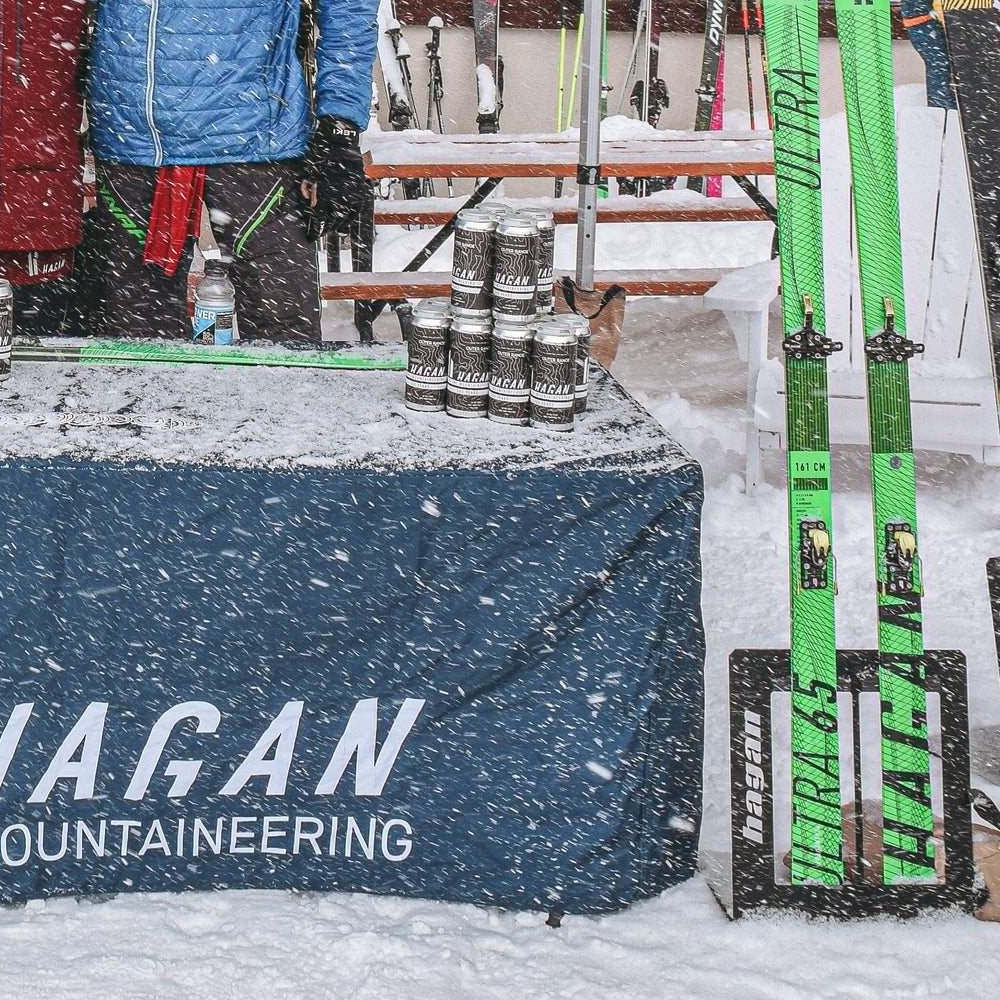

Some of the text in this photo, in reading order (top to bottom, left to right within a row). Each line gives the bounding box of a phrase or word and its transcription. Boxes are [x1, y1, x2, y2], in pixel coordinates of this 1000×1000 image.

[772, 68, 822, 190] ULTRA
[495, 272, 530, 286] HAGAN
[410, 363, 446, 377] HAGAN
[491, 375, 526, 389] HAGAN
[534, 381, 571, 395] HAGAN
[795, 462, 826, 472] 161 CM
[742, 709, 765, 845] hagan
[792, 672, 844, 887] ULTRA 65
